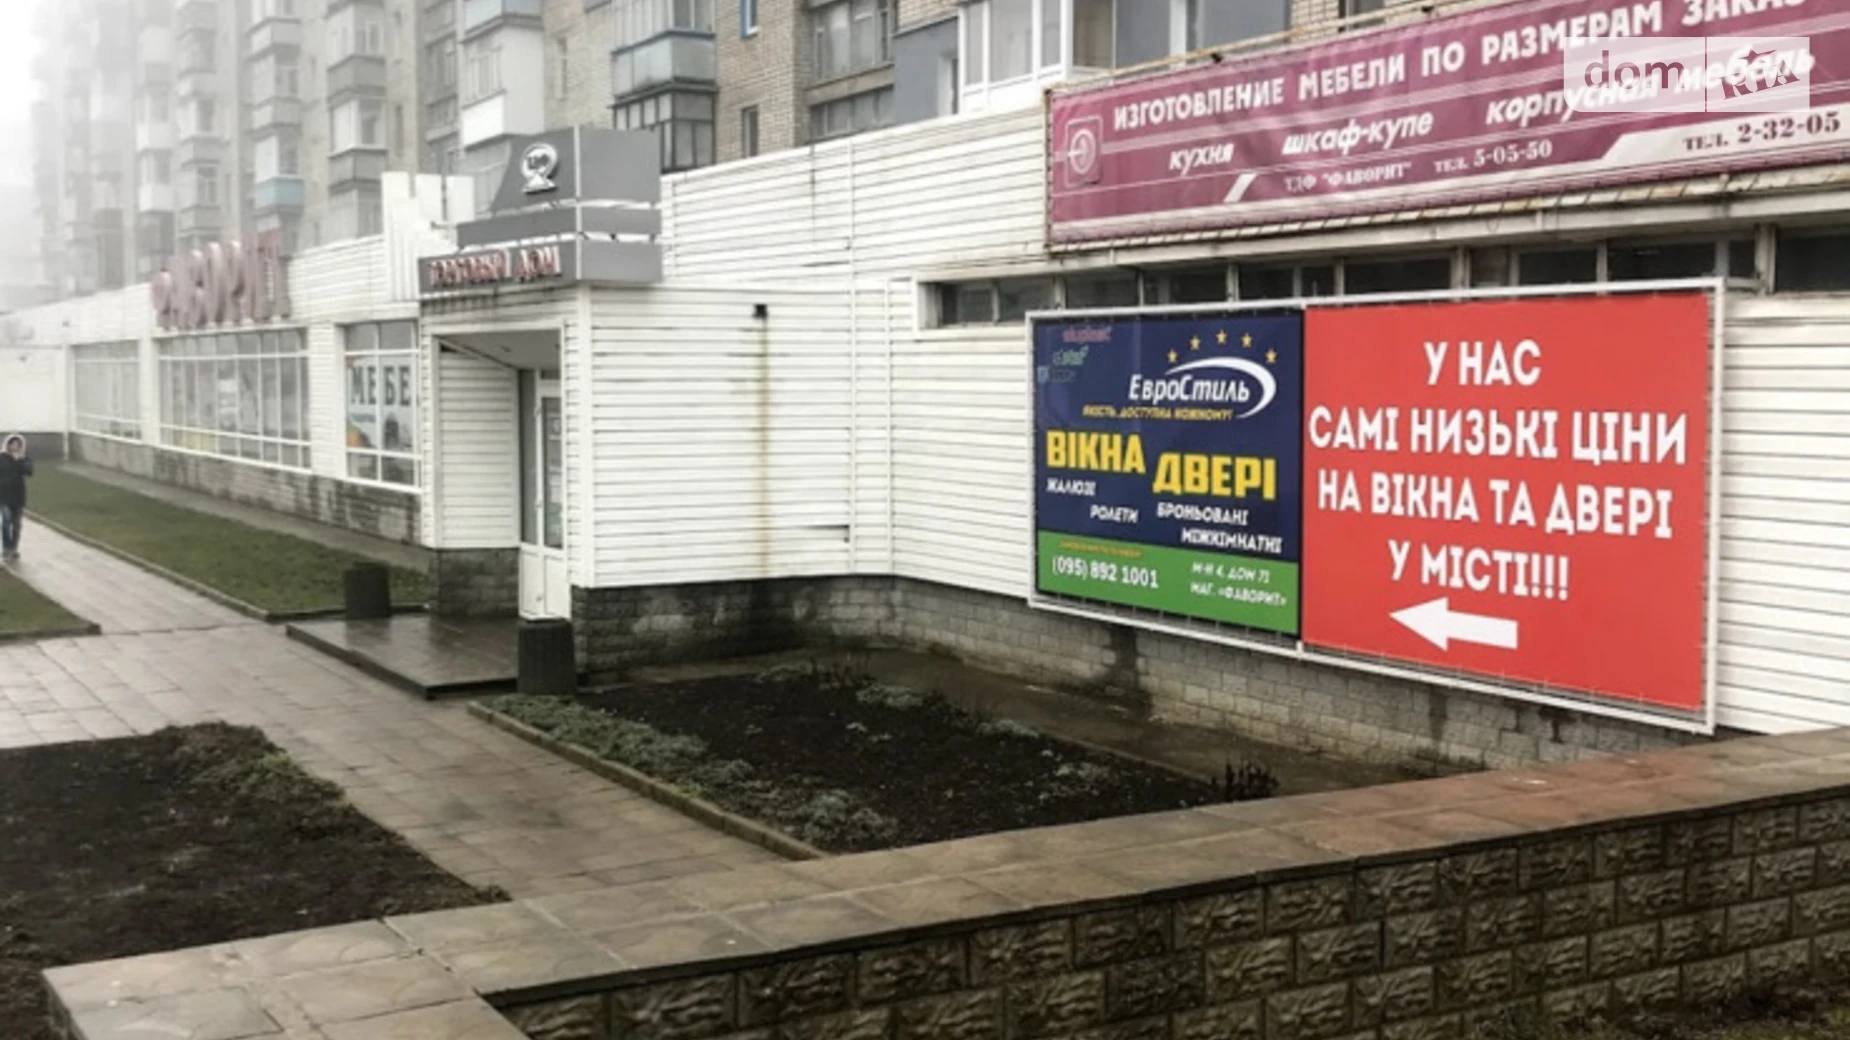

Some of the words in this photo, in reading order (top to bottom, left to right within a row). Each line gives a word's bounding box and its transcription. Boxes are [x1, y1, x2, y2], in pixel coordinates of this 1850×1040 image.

[1114, 78, 1285, 131] ИЗГОТОВЛЕНИЕ
[1298, 46, 1406, 100] МЕБЕЛИ
[1421, 43, 1466, 77] ПО
[1481, 0, 1663, 65] РАЗМЕРАМ
[1169, 143, 1235, 176] кухня
[1282, 110, 1434, 156] шкаф-купе
[1486, 71, 1661, 127] корпусная
[1673, 43, 1816, 95] мебель
[1737, 110, 1840, 144] 2-32-05
[1473, 140, 1552, 168] 5-05-50
[514, 246, 561, 280] ДОМ
[1423, 341, 1448, 386] У
[1458, 339, 1542, 386] НАС
[1128, 374, 1250, 405] ЕвроСтиль
[1046, 430, 1146, 474] ВІКНА
[1309, 406, 1399, 451] САМІ
[1410, 409, 1558, 458] НИЗЬКІ
[1572, 411, 1687, 465] ЦІНИ
[1047, 478, 1096, 496] ЖАЛЮЗІ
[1152, 452, 1277, 500] ДВЕРІ
[1090, 504, 1139, 523] РОЛЕТИ
[1156, 502, 1249, 526] БРОНЬОВАНІ
[1317, 469, 1361, 512] НА
[1371, 471, 1479, 523] ВІКНА
[1489, 479, 1537, 527] ТА
[1544, 483, 1673, 539] ДВЕРІ
[1181, 528, 1283, 554] МІЖКІМНАТНІ
[1052, 555, 1088, 580] (095)
[1090, 560, 1117, 582] 892
[1121, 565, 1159, 588] 1001
[1388, 540, 1411, 581] У
[1421, 544, 1569, 600] МІСТІ!!!
